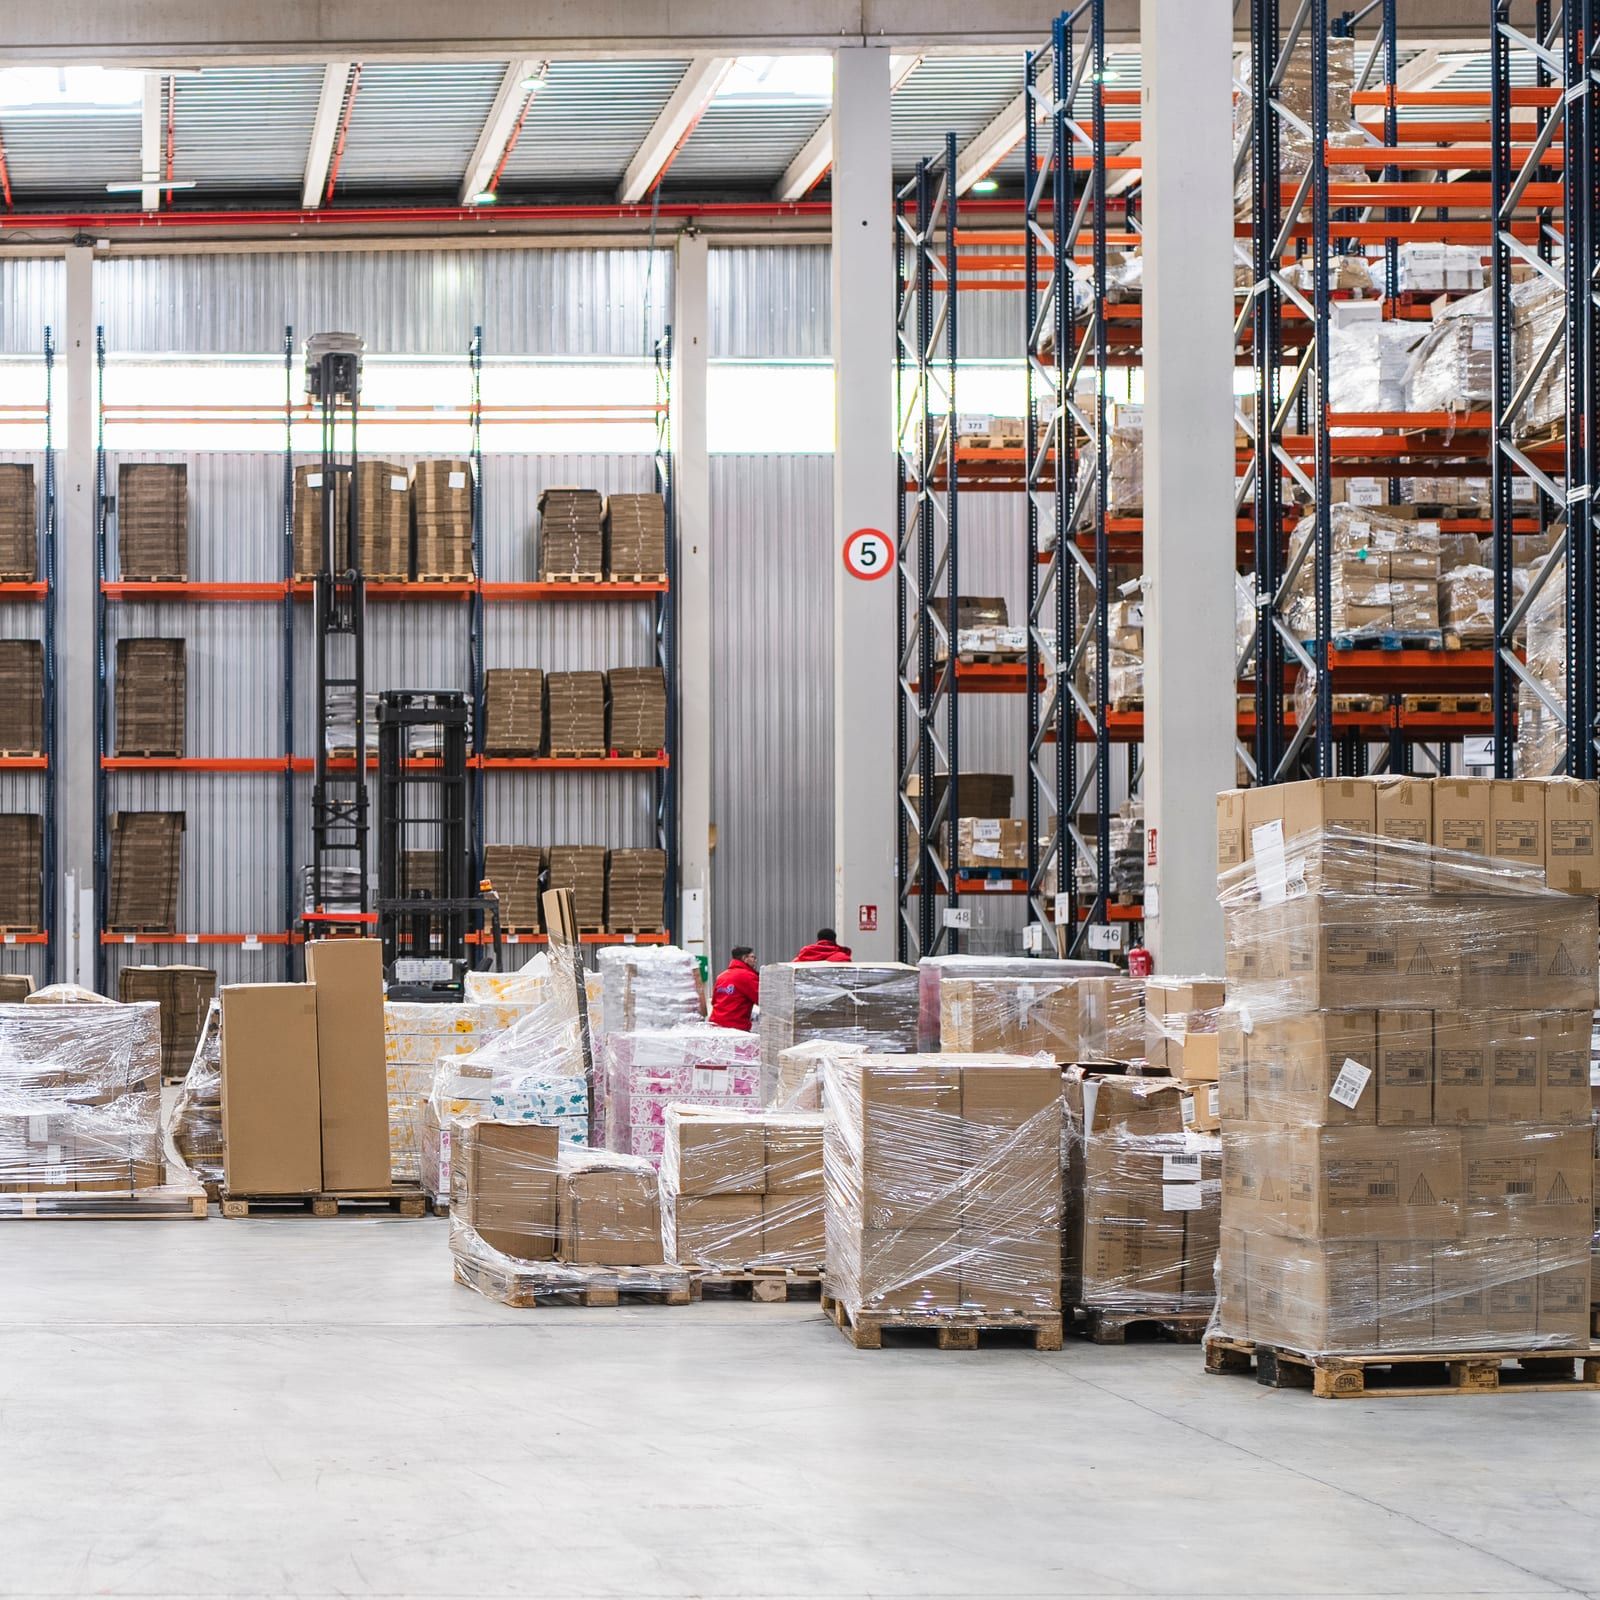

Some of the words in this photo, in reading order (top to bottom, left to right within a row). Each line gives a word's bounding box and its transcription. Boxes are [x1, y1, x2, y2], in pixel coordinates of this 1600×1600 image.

[860, 542, 877, 566] 5
[955, 911, 969, 922] 48
[1102, 928, 1119, 941] 46
